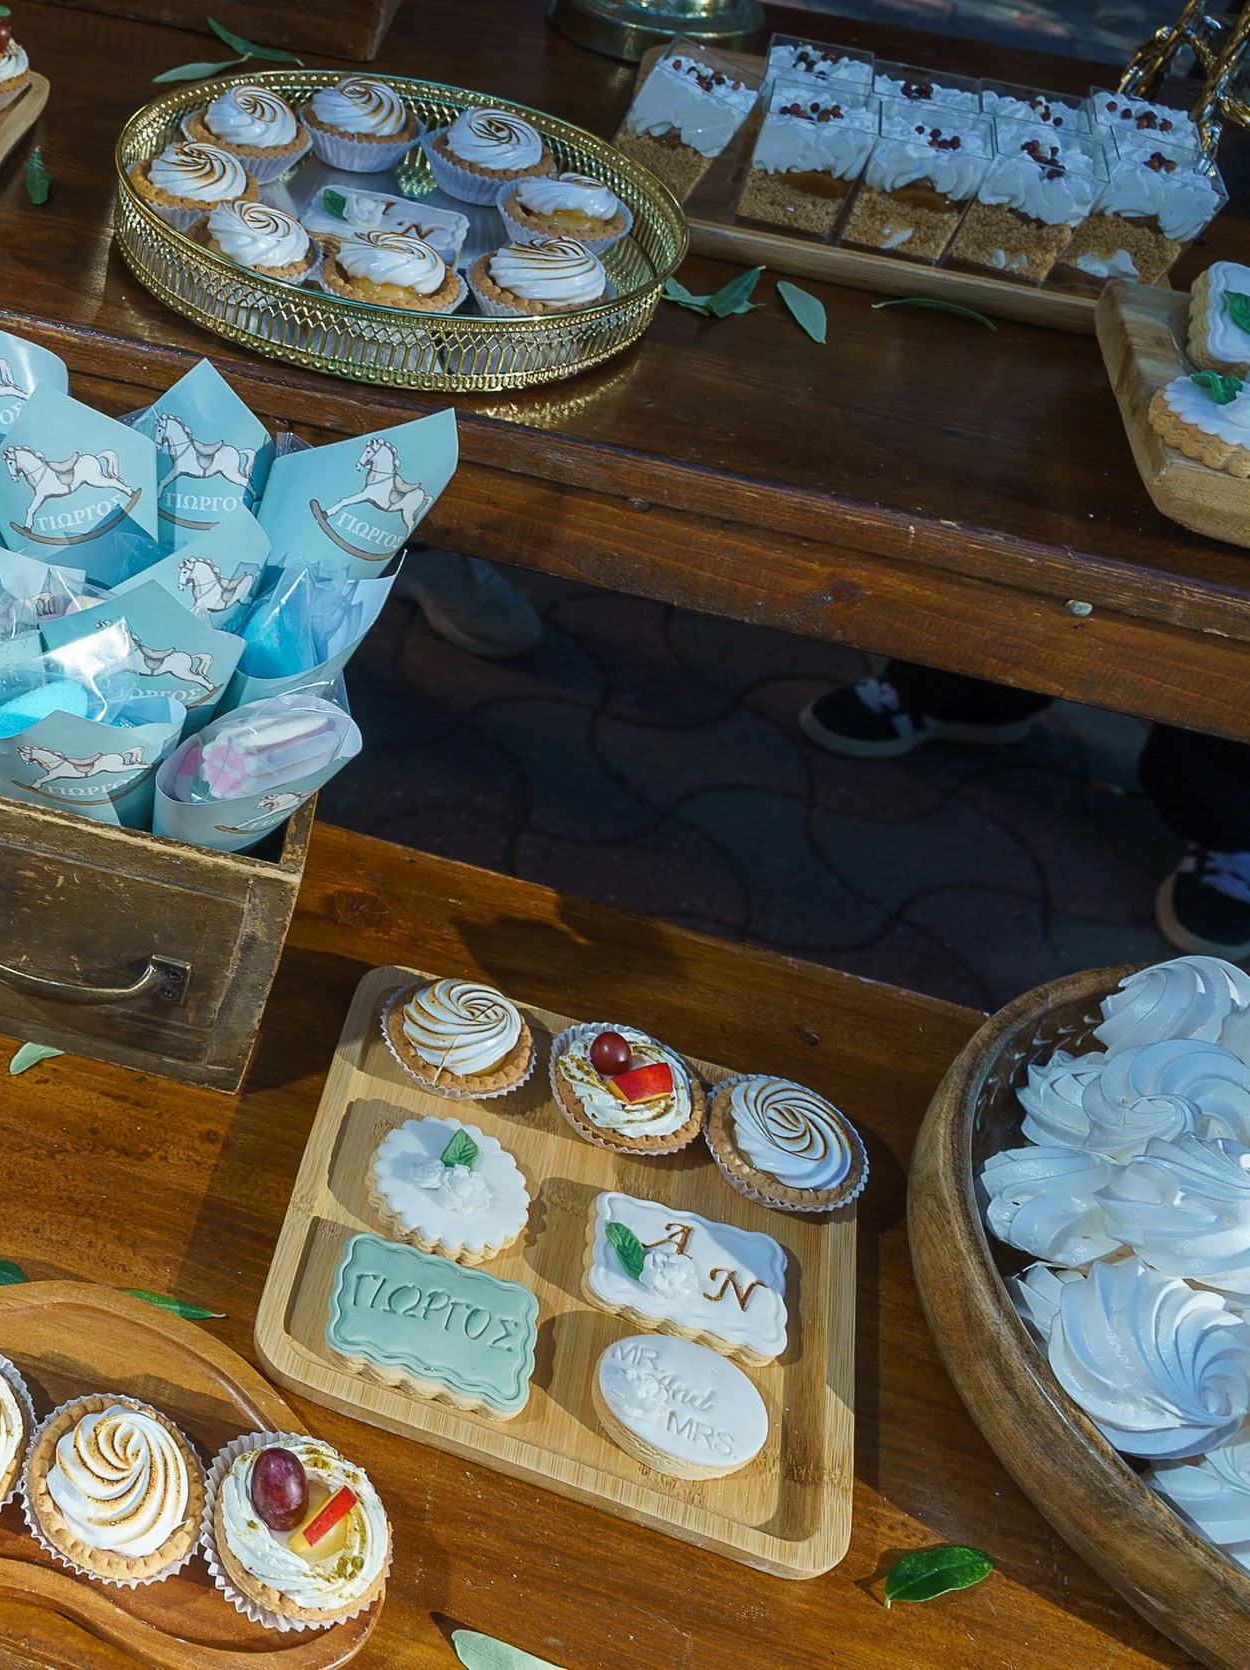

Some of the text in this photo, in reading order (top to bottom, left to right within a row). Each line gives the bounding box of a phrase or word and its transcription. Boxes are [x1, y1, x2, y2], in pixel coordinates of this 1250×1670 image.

[335, 511, 405, 549] ΓΙΩΡΓΟΣ
[641, 1223, 694, 1260] A
[703, 1267, 770, 1312] N
[352, 1273, 520, 1352] ΓΙΩΡΓΟΣ
